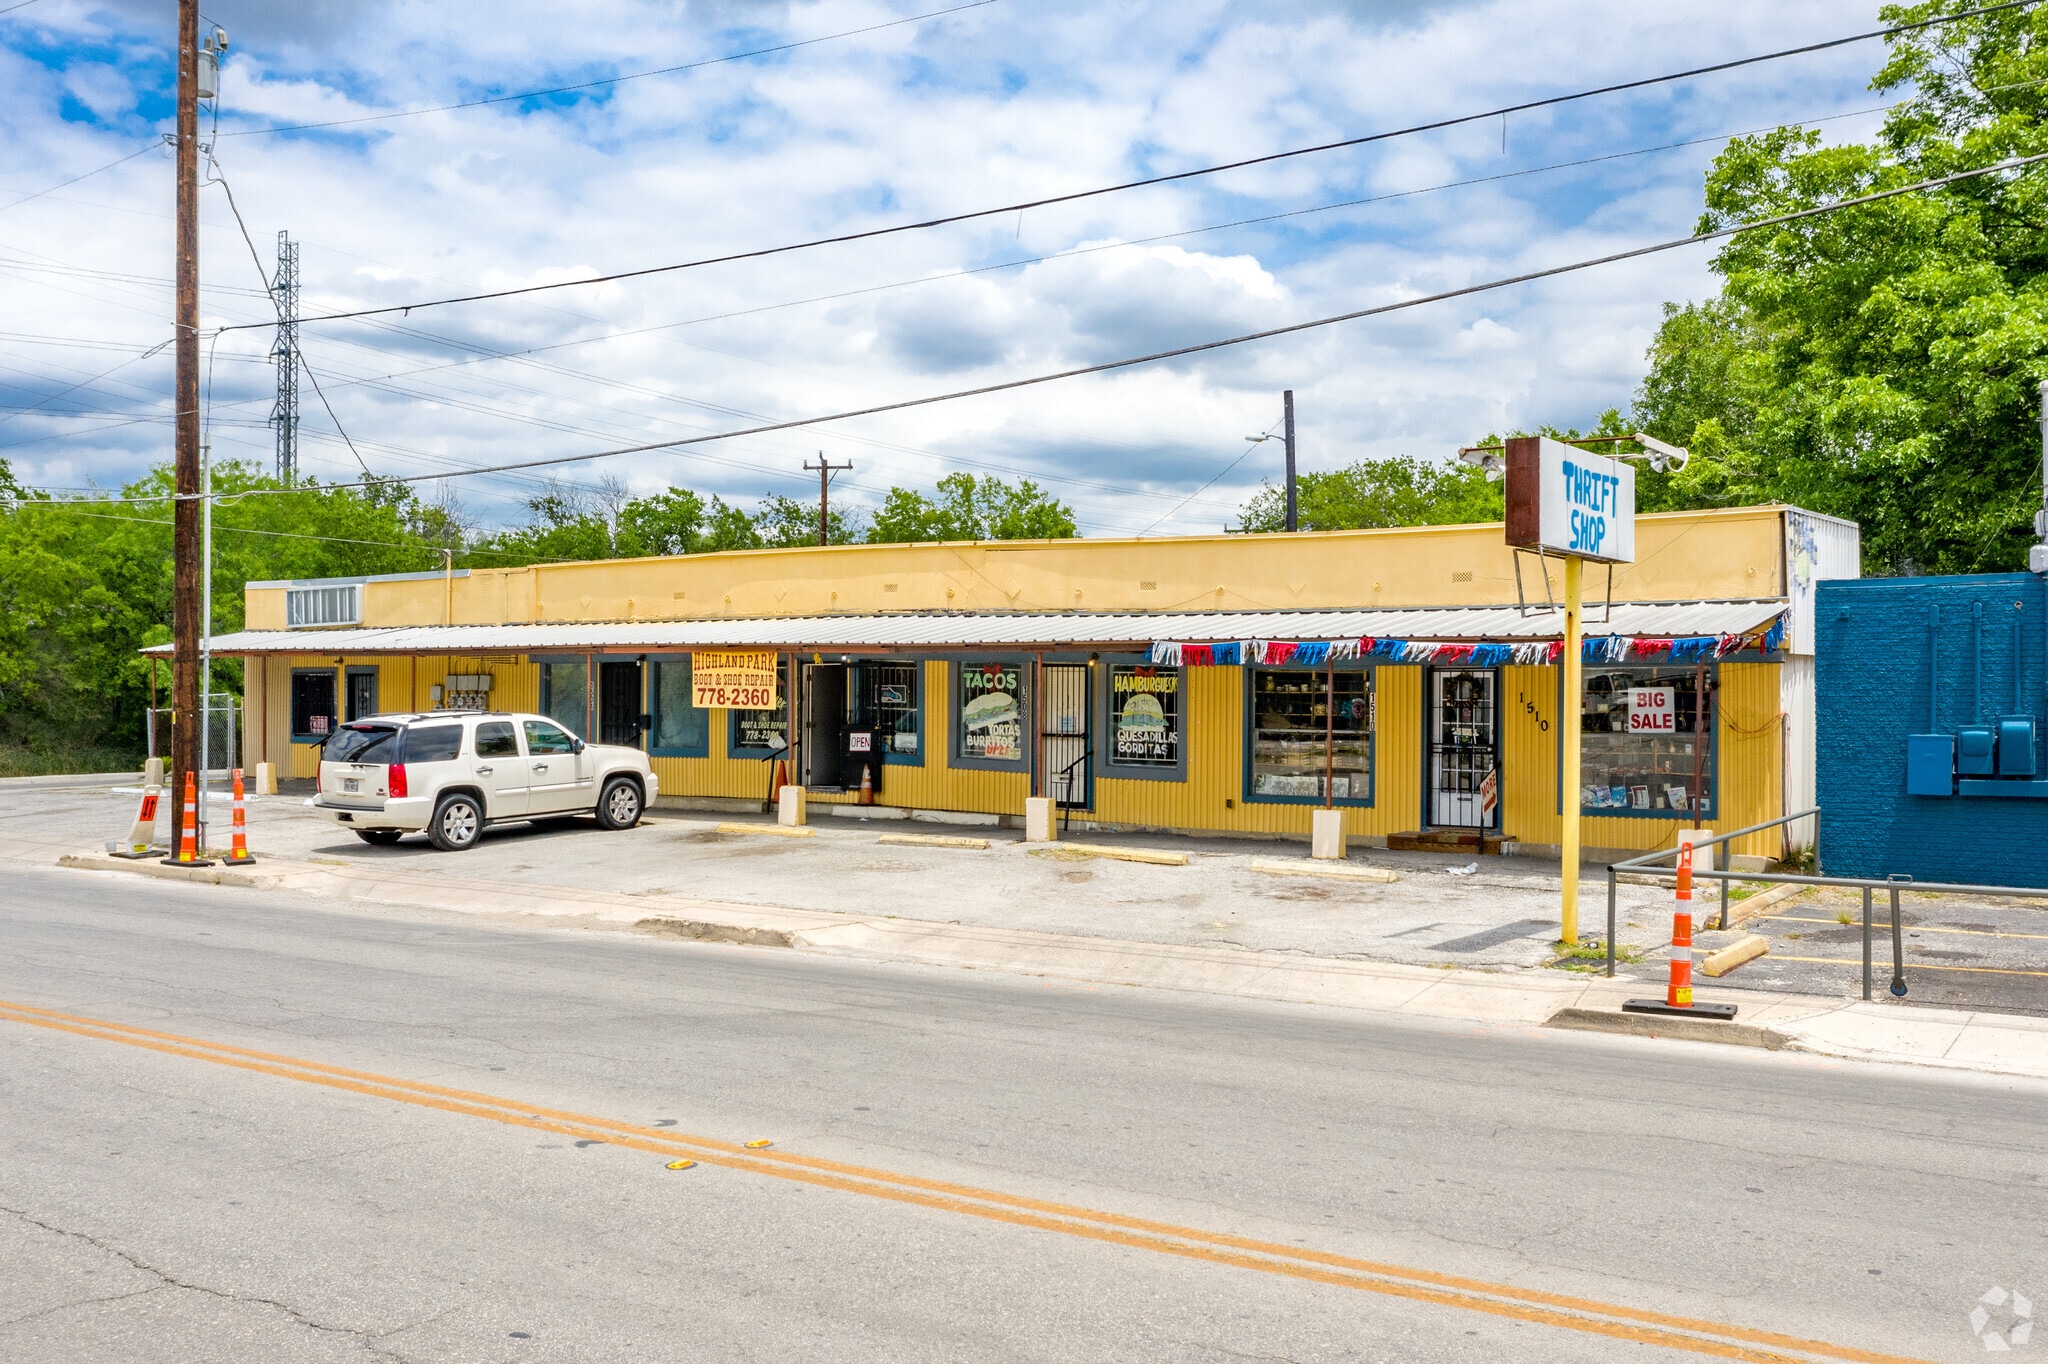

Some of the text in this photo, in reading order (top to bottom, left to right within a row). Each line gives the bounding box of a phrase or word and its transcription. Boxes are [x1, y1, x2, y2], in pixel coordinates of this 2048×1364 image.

[1562, 460, 1619, 518] THRIFT
[1569, 508, 1605, 554] SHOP
[694, 652, 775, 672] HIGHLAND PARK
[694, 673, 773, 687] BOOT & SHOE REPAIR
[964, 673, 1017, 689] TACOS
[697, 687, 769, 706] 778-2360
[1637, 692, 1665, 707] BIG
[1519, 692, 1549, 731] 1510
[1631, 713, 1673, 729] SALE
[988, 724, 1020, 736] TORTAS
[1117, 730, 1178, 743] QUESADILLAS
[851, 736, 870, 748] OPEN
[966, 735, 1015, 749] BURRITOS
[1118, 742, 1168, 755] GORDITAS
[1481, 774, 1496, 799] MORE
